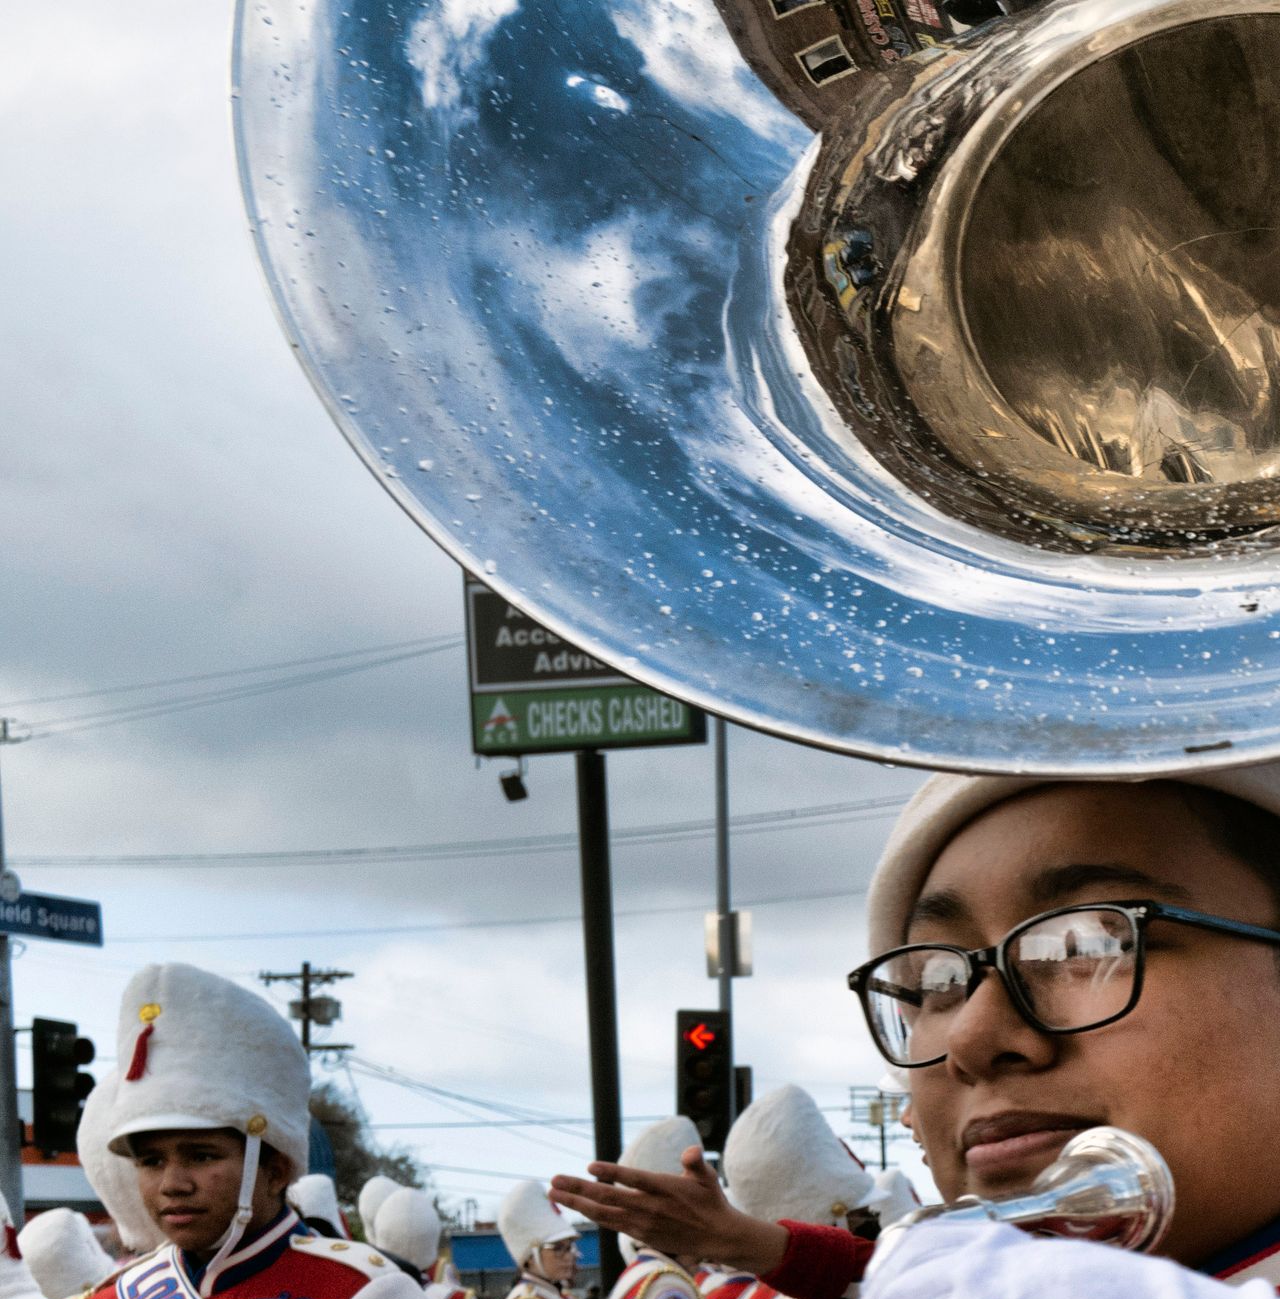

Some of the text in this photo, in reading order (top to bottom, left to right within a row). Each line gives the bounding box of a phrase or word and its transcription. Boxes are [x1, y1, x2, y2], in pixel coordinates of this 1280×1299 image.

[527, 696, 684, 739] CHECKS CASHED
[38, 907, 97, 933] Square
